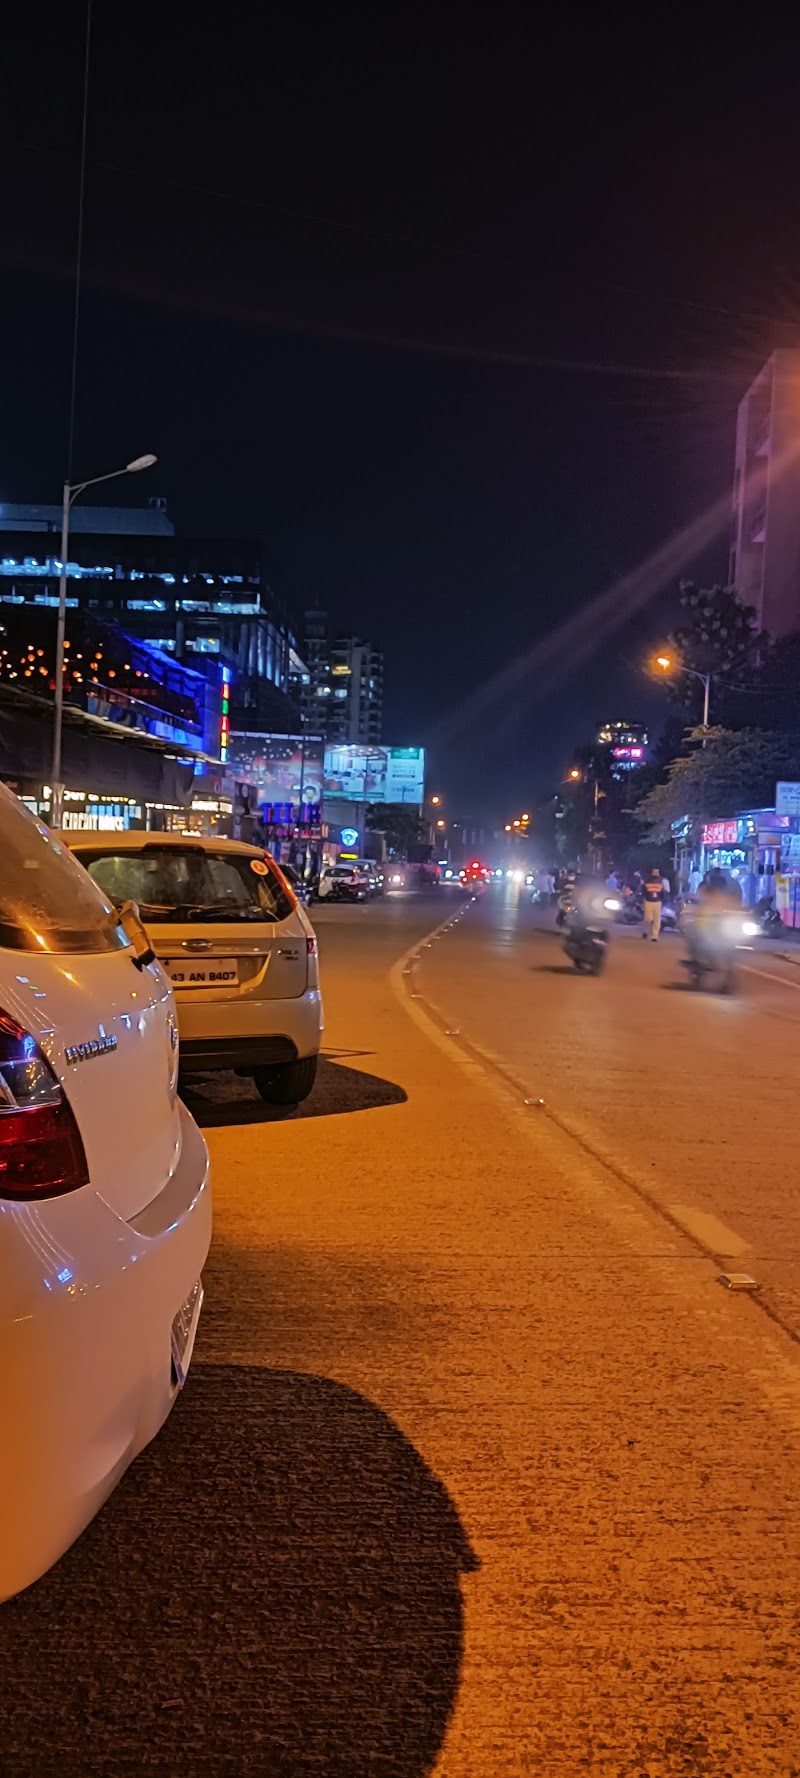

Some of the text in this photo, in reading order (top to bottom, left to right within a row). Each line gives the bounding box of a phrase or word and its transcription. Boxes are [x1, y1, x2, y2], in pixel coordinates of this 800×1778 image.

[171, 971, 236, 982] 43 AN 8407
[65, 1035, 118, 1065] HYUNDAI
